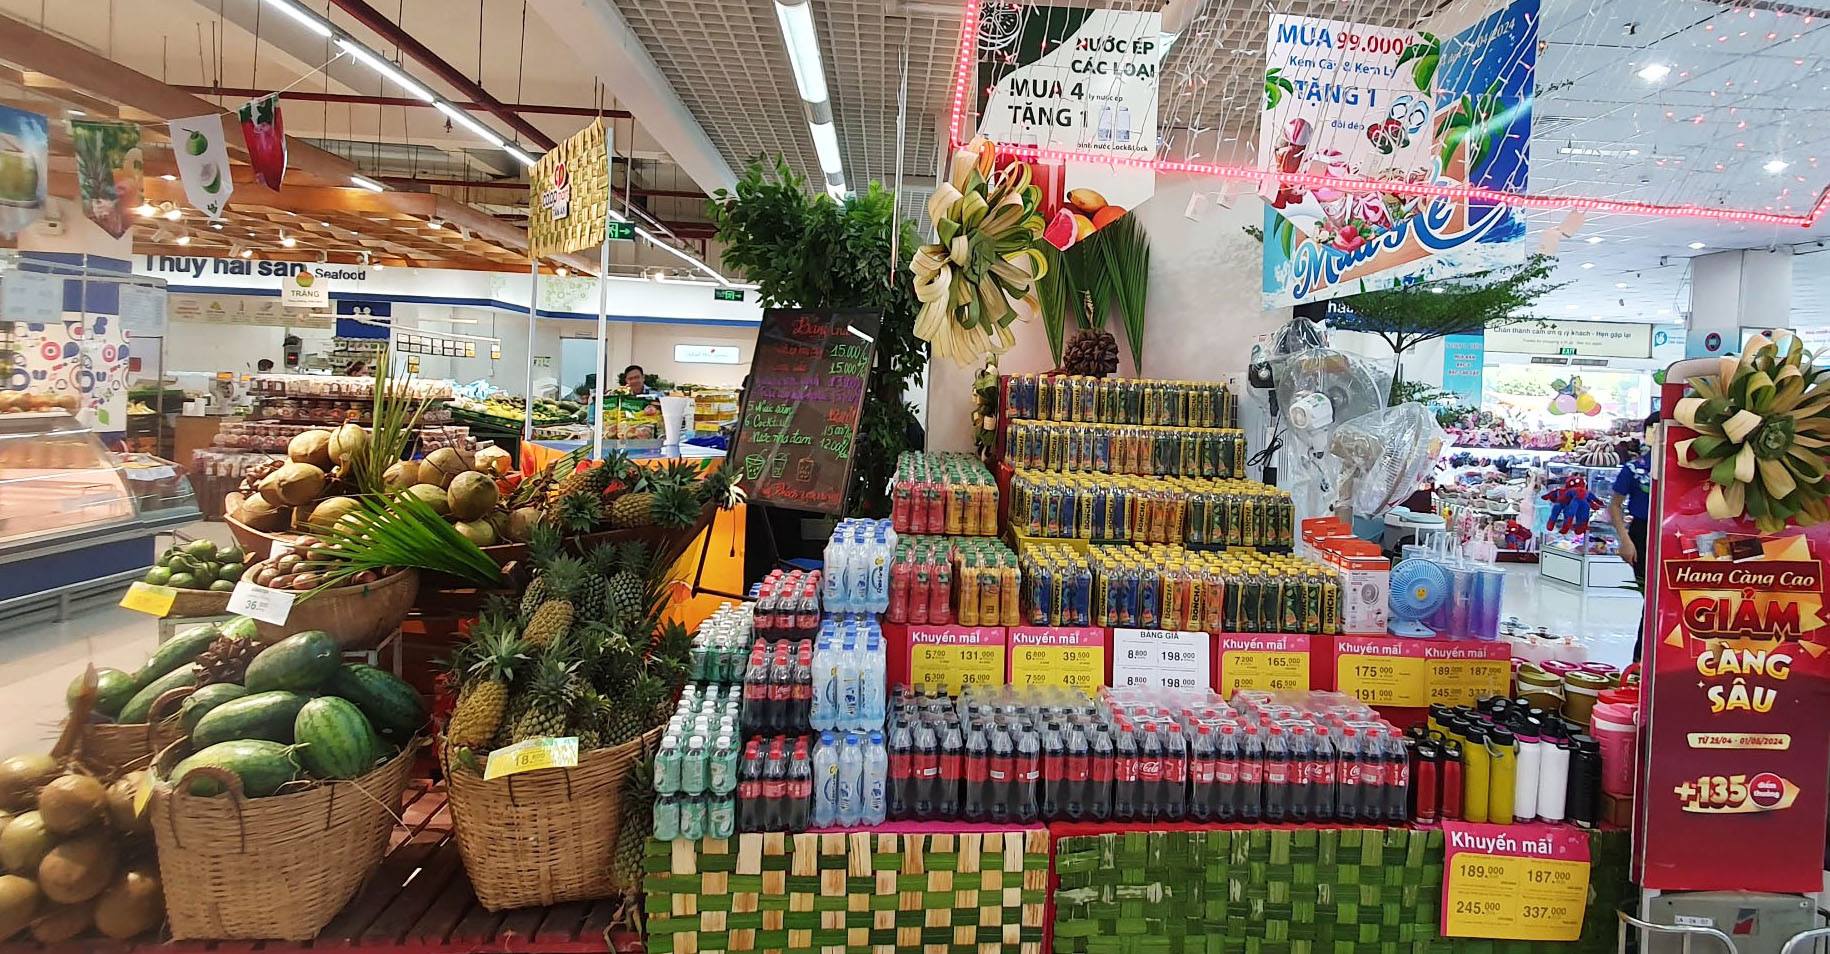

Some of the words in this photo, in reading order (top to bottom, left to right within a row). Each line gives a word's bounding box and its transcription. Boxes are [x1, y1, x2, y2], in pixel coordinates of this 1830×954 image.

[1277, 23, 1332, 49] MUA
[1071, 56, 1108, 75] CÁC
[1113, 61, 1155, 81] LOẠI
[1289, 55, 1315, 68] Kem
[1342, 61, 1352, 73] &
[1354, 62, 1381, 76] Kem
[1009, 77, 1063, 99] MUA
[1070, 82, 1084, 100] 4
[1294, 76, 1359, 107] TẶNG
[1367, 88, 1376, 108] 1
[1007, 101, 1072, 131] TẶNG
[1080, 110, 1088, 128] 1
[315, 267, 366, 281] Seafood
[1192, 584, 1201, 621] BONCHA
[1683, 586, 1802, 642] GIẢM
[960, 650, 994, 660] 131.000
[1161, 652, 1195, 661] 198.000
[1696, 641, 1793, 681] CÀNG
[1355, 666, 1394, 678] 175.000
[1160, 678, 1195, 688] 198.000
[1355, 689, 1393, 700] 191.000
[1707, 677, 1777, 714] SÂU
[1673, 775, 1748, 808] +135
[1460, 865, 1504, 879] 189.000
[1528, 870, 1571, 884] 187.000
[1456, 901, 1500, 915] 245.000
[1523, 905, 1567, 919] 337.000
